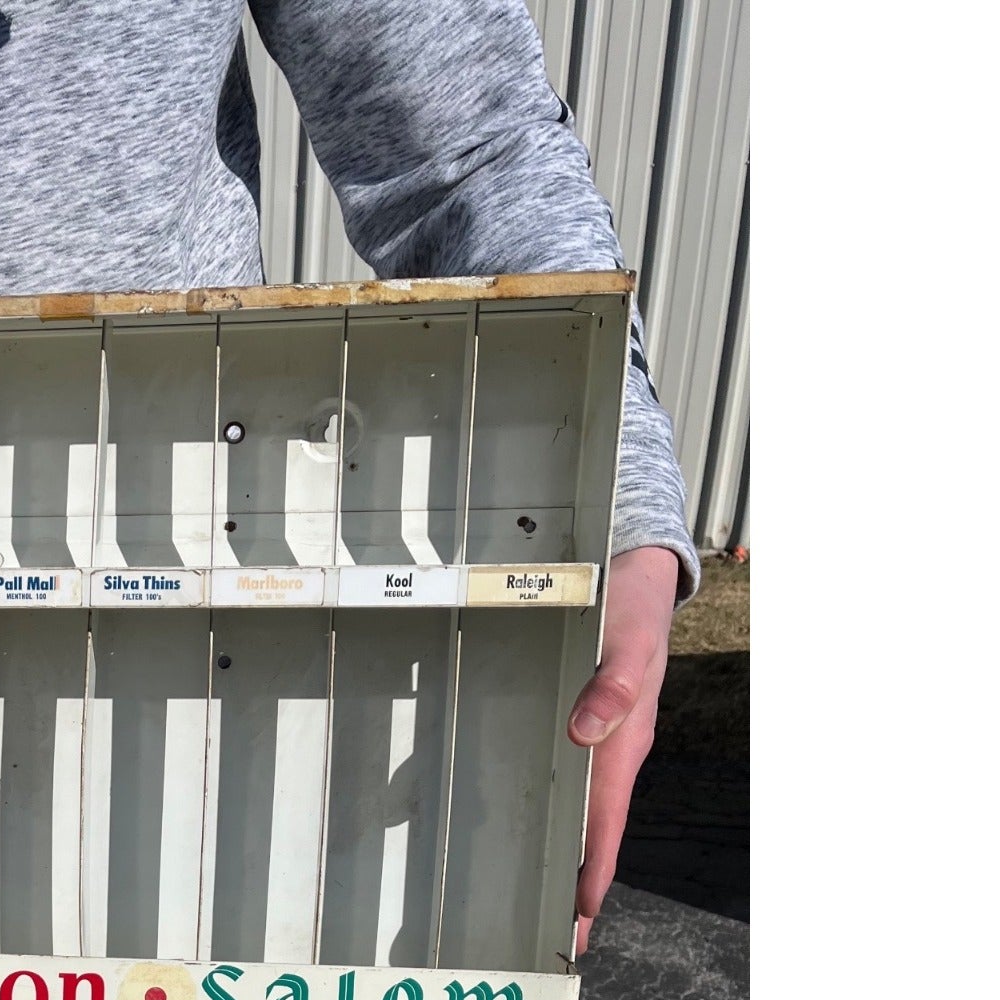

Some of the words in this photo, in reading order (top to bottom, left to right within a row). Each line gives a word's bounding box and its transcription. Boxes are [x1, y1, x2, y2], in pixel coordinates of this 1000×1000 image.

[103, 575, 139, 590] Silva
[142, 575, 181, 590] Thins
[237, 575, 304, 590] Marlboro
[385, 573, 413, 588] Kool
[507, 574, 553, 591] Raleigh
[6, 593, 34, 601] MENTHOL
[36, 593, 47, 601] 100
[122, 593, 142, 601] FILTER
[145, 593, 162, 601] 100's
[384, 590, 413, 598] REGULAR
